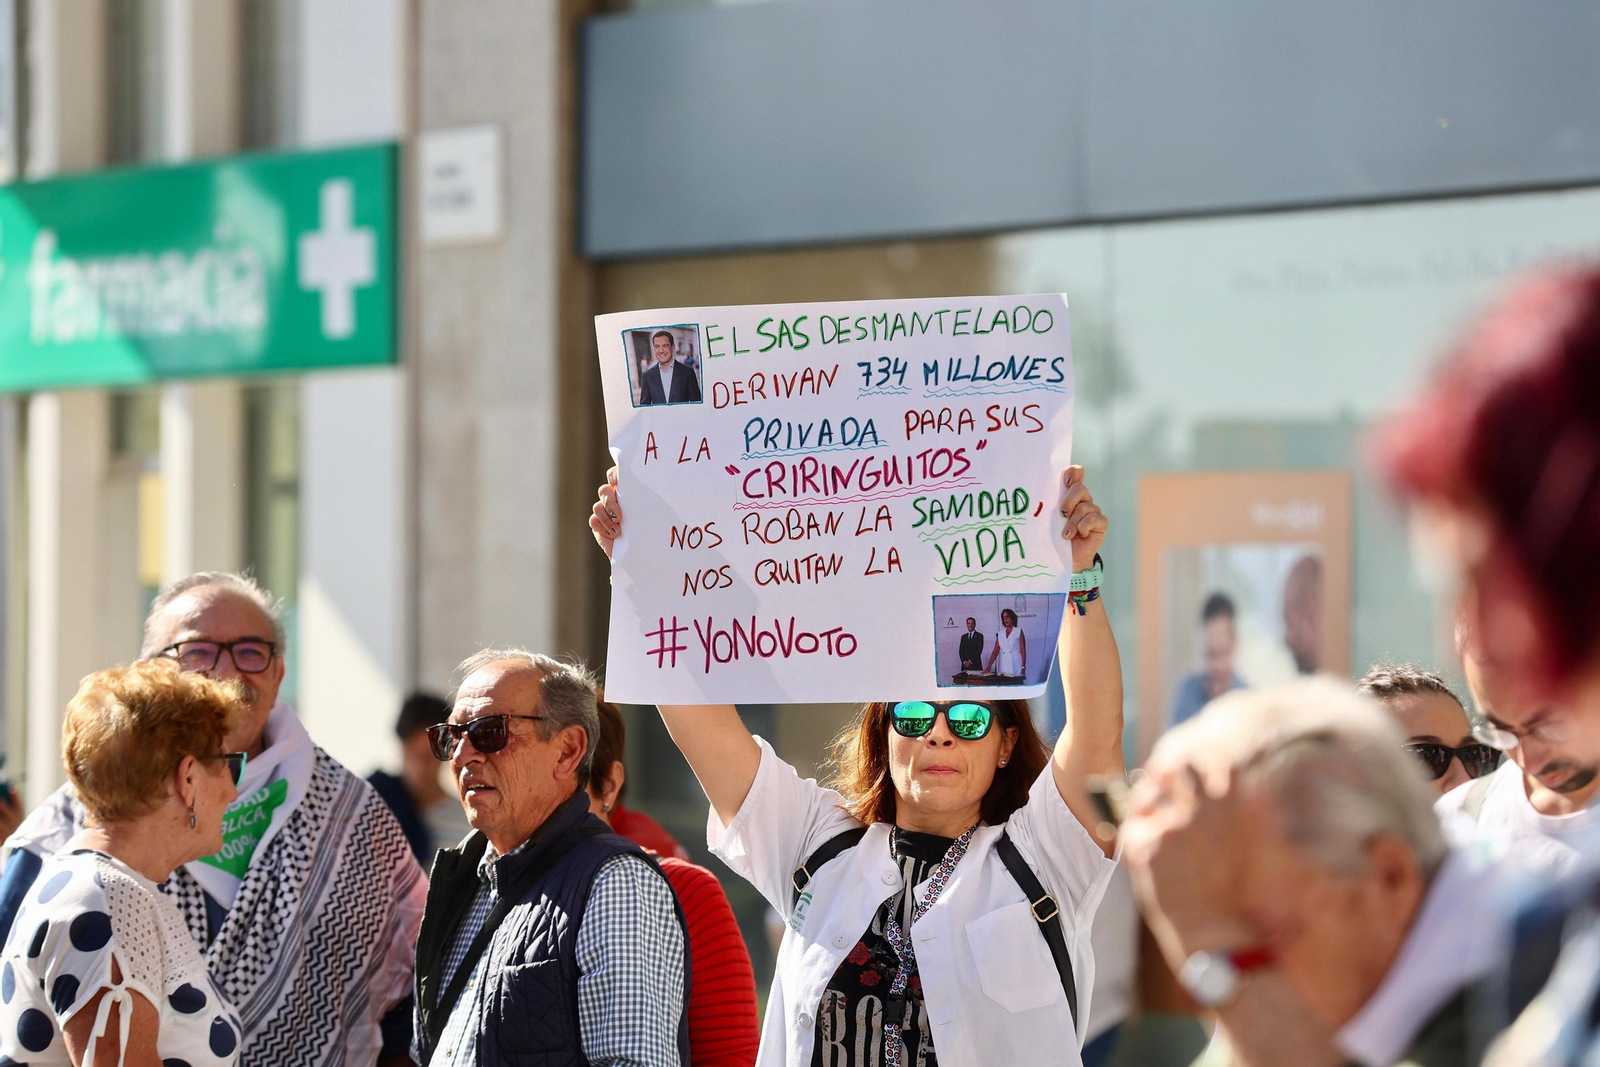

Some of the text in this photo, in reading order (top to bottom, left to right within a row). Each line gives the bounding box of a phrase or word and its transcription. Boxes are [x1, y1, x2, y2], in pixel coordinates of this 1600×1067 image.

[705, 305, 1054, 359] EL SAS DESMANTELADO
[712, 354, 1066, 410] DERIVAN 734 MILLONES
[644, 404, 1044, 466] A LA PRIVADA PARA SUS
[670, 521, 723, 550] NOS
[741, 507, 844, 545] ROBAN
[854, 504, 893, 537] LA
[682, 523, 1026, 597] NOS QUITAN LA VIDA
[220, 804, 267, 836] BLICA
